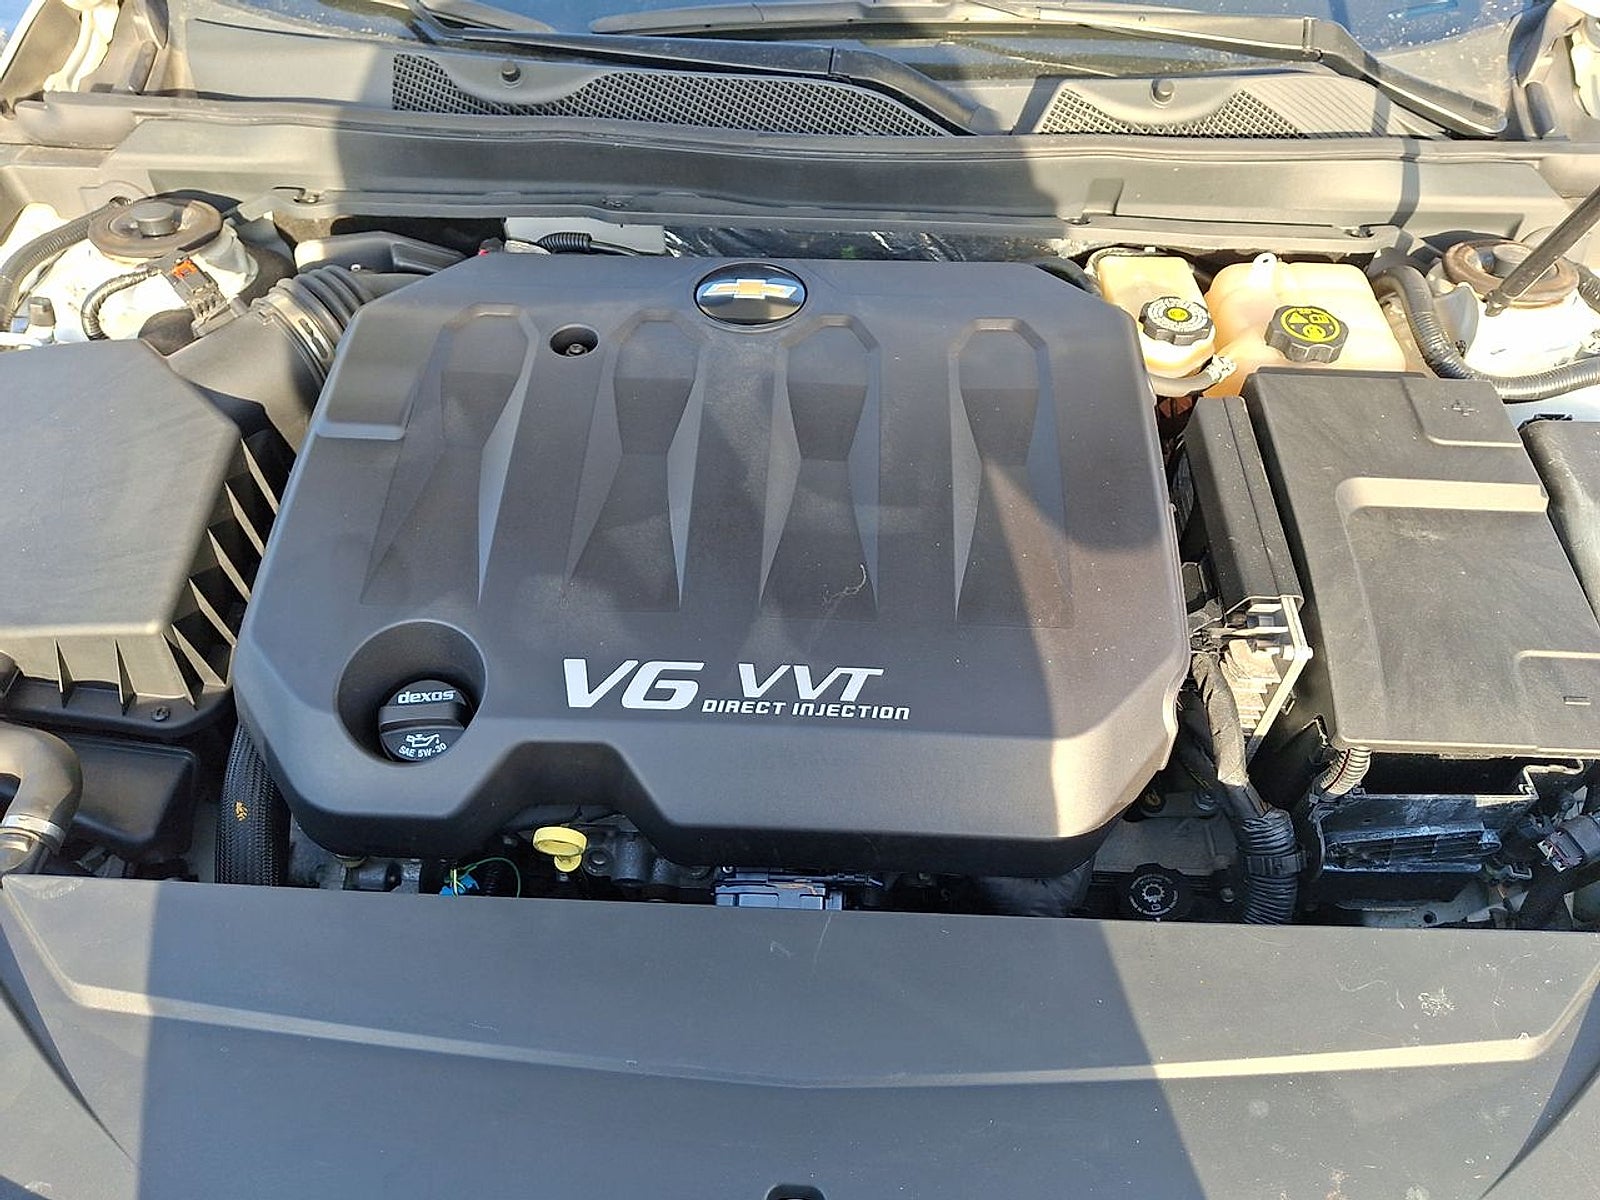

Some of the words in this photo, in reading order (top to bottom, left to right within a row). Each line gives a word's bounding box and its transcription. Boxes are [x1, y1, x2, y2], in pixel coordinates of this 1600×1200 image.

[563, 658, 704, 710] V6
[738, 663, 884, 702] VVT
[397, 690, 456, 704] dexos
[701, 699, 786, 715] DIRECT
[791, 702, 910, 720] INJECTION
[398, 745, 415, 758] SAE
[417, 742, 448, 758] 5W-30
